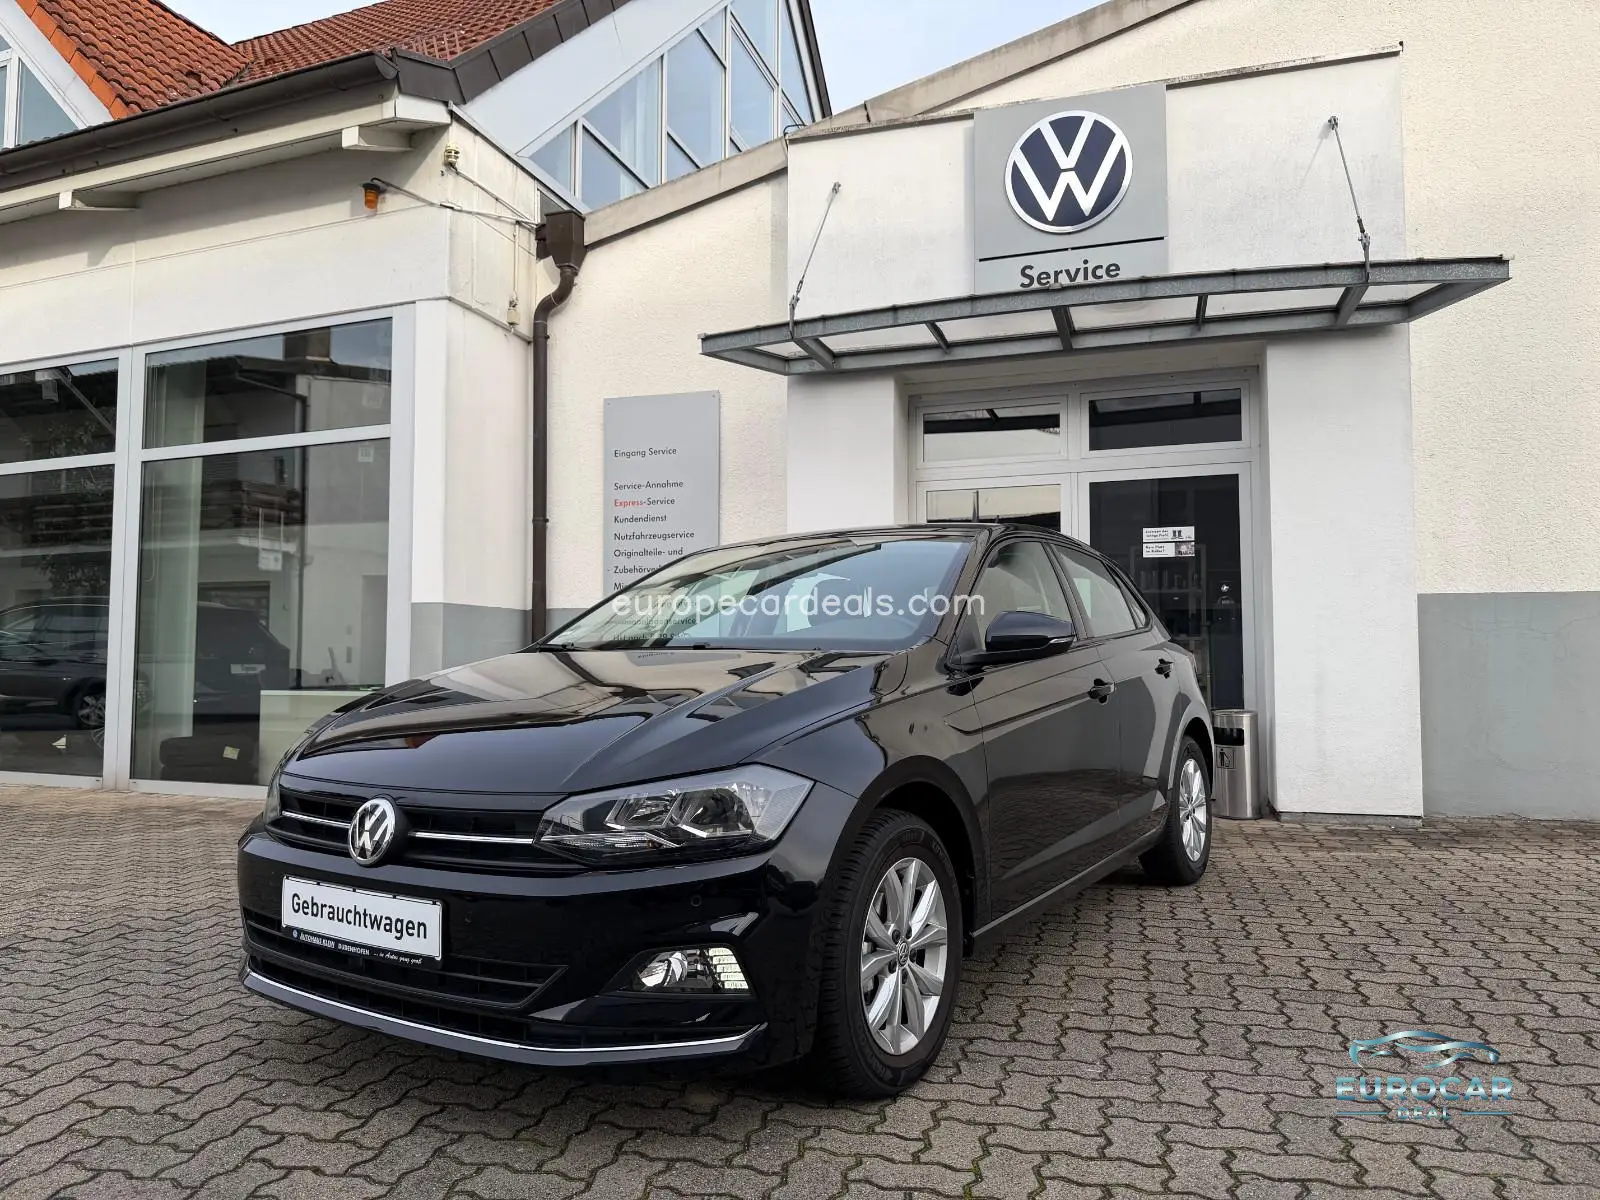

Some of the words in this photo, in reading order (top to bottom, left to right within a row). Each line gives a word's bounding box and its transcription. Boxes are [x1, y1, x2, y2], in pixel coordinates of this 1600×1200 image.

[1019, 258, 1121, 288] Service
[613, 449, 646, 459] Eingang
[648, 447, 677, 456] Service
[613, 480, 684, 491] Service-Annahme
[613, 497, 676, 508] Express-Service
[613, 514, 667, 524] Kundendienst
[613, 530, 695, 541] Nutzfahrzeugservice
[613, 547, 665, 558] Originalteile-
[667, 547, 684, 556] und
[291, 892, 428, 941] Gebrauchtwagen
